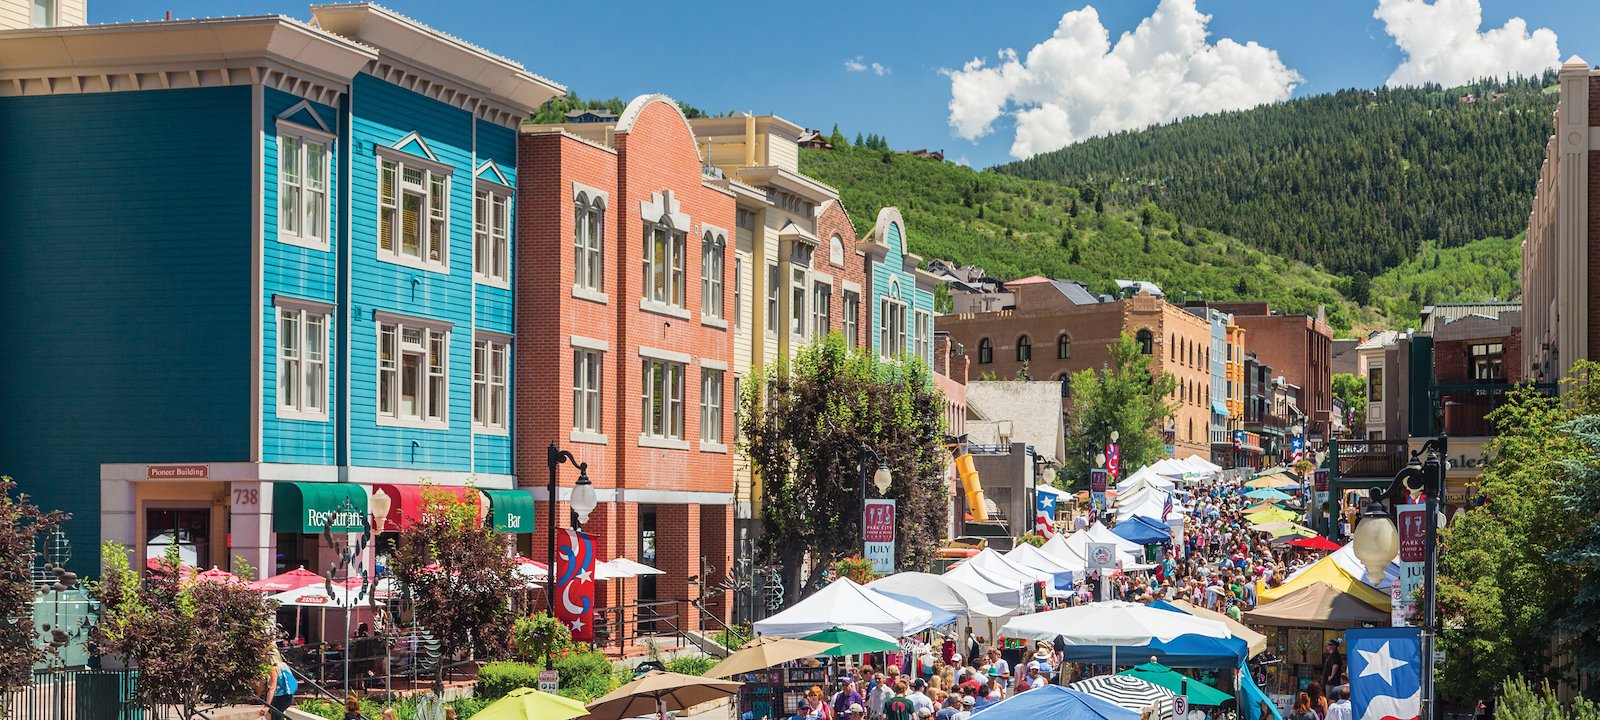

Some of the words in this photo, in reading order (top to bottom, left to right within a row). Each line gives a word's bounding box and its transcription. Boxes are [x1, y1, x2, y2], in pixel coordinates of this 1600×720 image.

[177, 468, 204, 477] Building
[233, 489, 258, 505] 738
[508, 513, 521, 528] Bar
[870, 546, 890, 554] JULY
